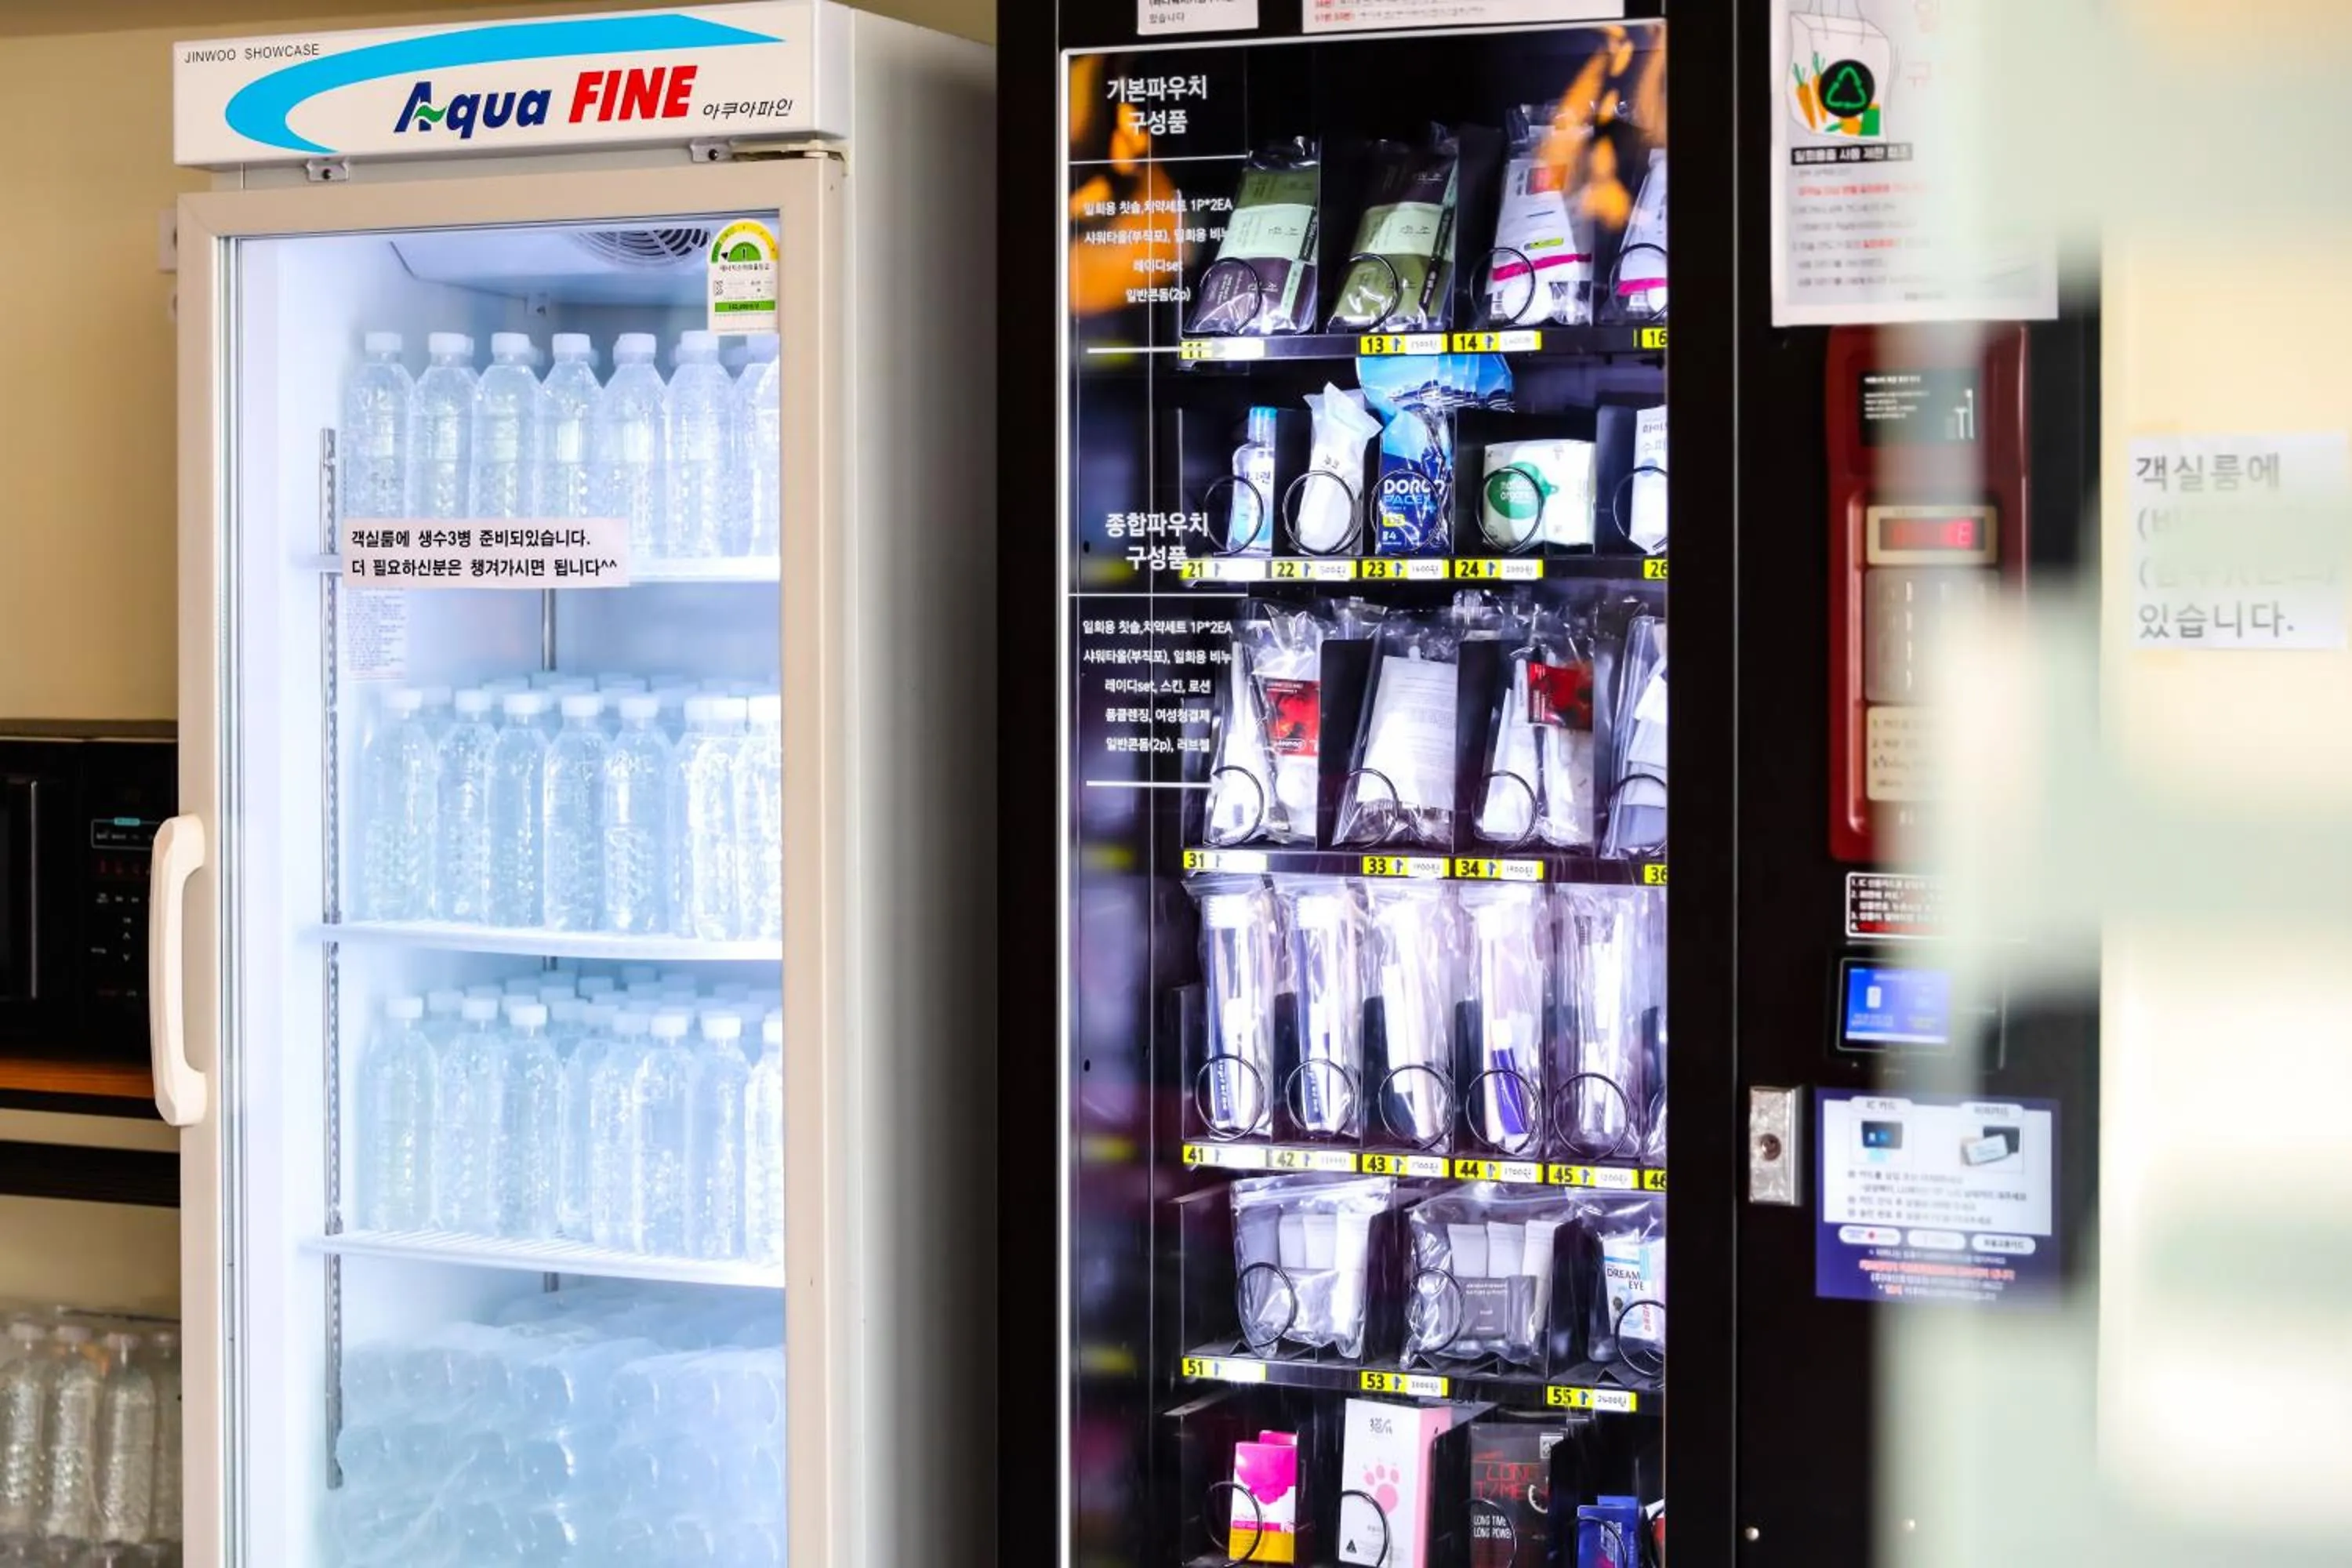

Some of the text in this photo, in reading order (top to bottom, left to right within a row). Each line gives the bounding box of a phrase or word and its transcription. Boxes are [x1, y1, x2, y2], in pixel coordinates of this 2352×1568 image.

[185, 44, 320, 64] JINWOO SHOWCASE
[1106, 75, 1207, 103] 기본파우치
[394, 65, 699, 139] Aqua FINE
[702, 98, 793, 120] 아쿠아파인
[1127, 109, 1189, 136] 구성품
[1367, 336, 1385, 354] 13
[1459, 335, 1477, 351] 14
[1649, 330, 1667, 347] 16
[2136, 451, 2280, 492] 객실룸에
[1105, 512, 1208, 538] 종합파우치
[351, 530, 591, 548] 객실룸에 생수3병 준비되있습니다.
[1126, 546, 1189, 571] 구성품
[352, 560, 365, 576] 더
[372, 559, 463, 576] 필요하신분은
[470, 559, 546, 576] 챙겨가시면
[1188, 562, 1203, 578] 21
[1276, 562, 1294, 578] 22
[1367, 561, 1385, 578] 23
[1460, 561, 1479, 578] 24
[1650, 561, 1668, 578] 26
[1083, 620, 1115, 634] 일회용
[1118, 620, 1187, 634] 칫솔,치약세트
[2138, 599, 2295, 639] 있습니다.
[1173, 650, 1207, 665] 일회용
[1210, 650, 1232, 665] 비누
[1160, 680, 1186, 694] 스킨,
[1189, 680, 1211, 693] 로션
[1189, 853, 1204, 868] 31
[1368, 858, 1386, 874] 33
[1461, 860, 1480, 877] 34
[1650, 866, 1668, 884] 36
[1189, 1147, 1203, 1163] 41
[1277, 1152, 1294, 1167] 42
[1367, 1156, 1385, 1172] 43
[1460, 1161, 1479, 1178] 44
[1554, 1167, 1573, 1183] 45
[1606, 1268, 1641, 1279] DREAM
[1188, 1360, 1203, 1376] 51
[1367, 1373, 1385, 1390] 53
[1552, 1388, 1572, 1406] 55
[1473, 1515, 1490, 1526] LONG
[1473, 1526, 1490, 1538] LONG
